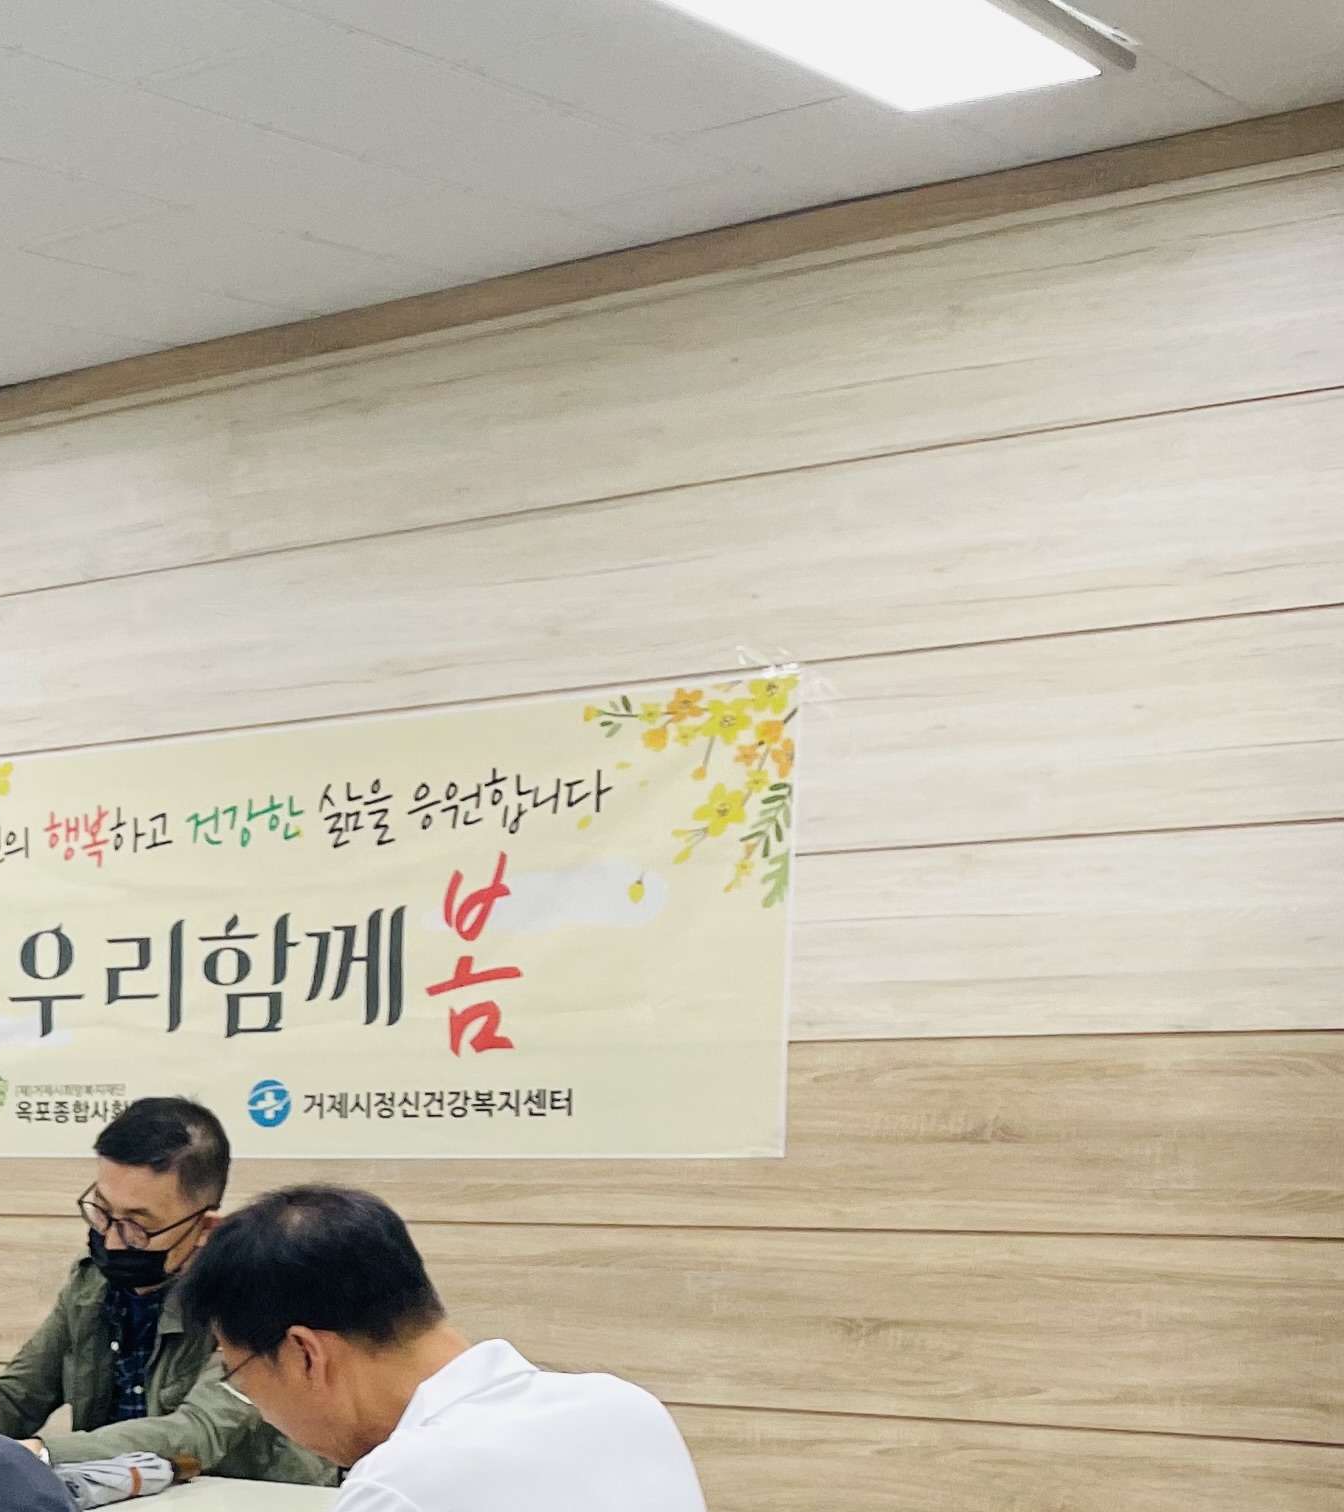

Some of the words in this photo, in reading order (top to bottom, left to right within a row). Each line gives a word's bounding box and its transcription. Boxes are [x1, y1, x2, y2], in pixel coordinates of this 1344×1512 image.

[43, 804, 173, 868] 행복하고
[185, 794, 304, 848] 건강한
[318, 777, 396, 849] 삶을
[407, 767, 613, 834] 응원합니다
[8, 904, 407, 1039] 우리함께
[425, 850, 524, 1057] 봄
[302, 1087, 574, 1119] 거제시정신건강복지센터
